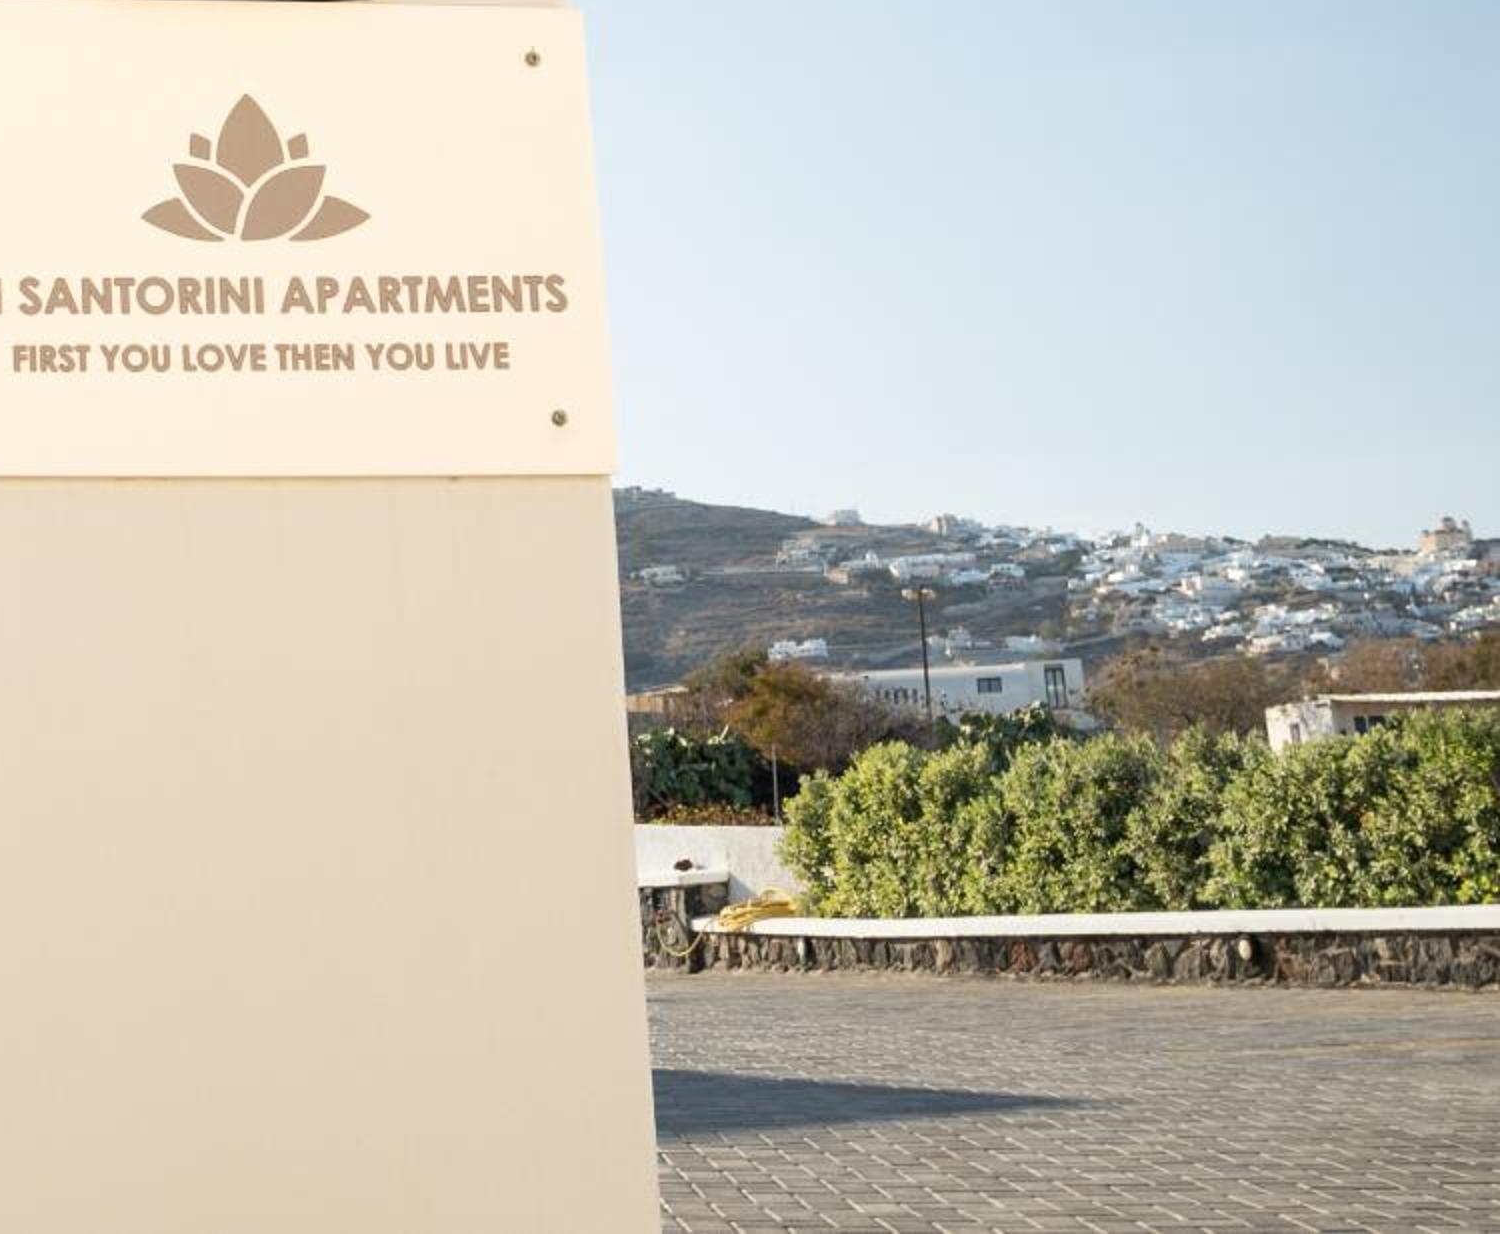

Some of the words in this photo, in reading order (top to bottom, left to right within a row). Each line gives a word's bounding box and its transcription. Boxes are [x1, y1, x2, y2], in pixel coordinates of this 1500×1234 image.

[18, 276, 266, 316] SANTORINI
[280, 274, 569, 314] APARTMENTS
[12, 344, 91, 373] FIRST
[99, 344, 171, 373] YOU
[182, 344, 267, 372] LOVE
[274, 343, 355, 371] THEN
[365, 342, 435, 371] YOU
[445, 342, 510, 371] LIVE
